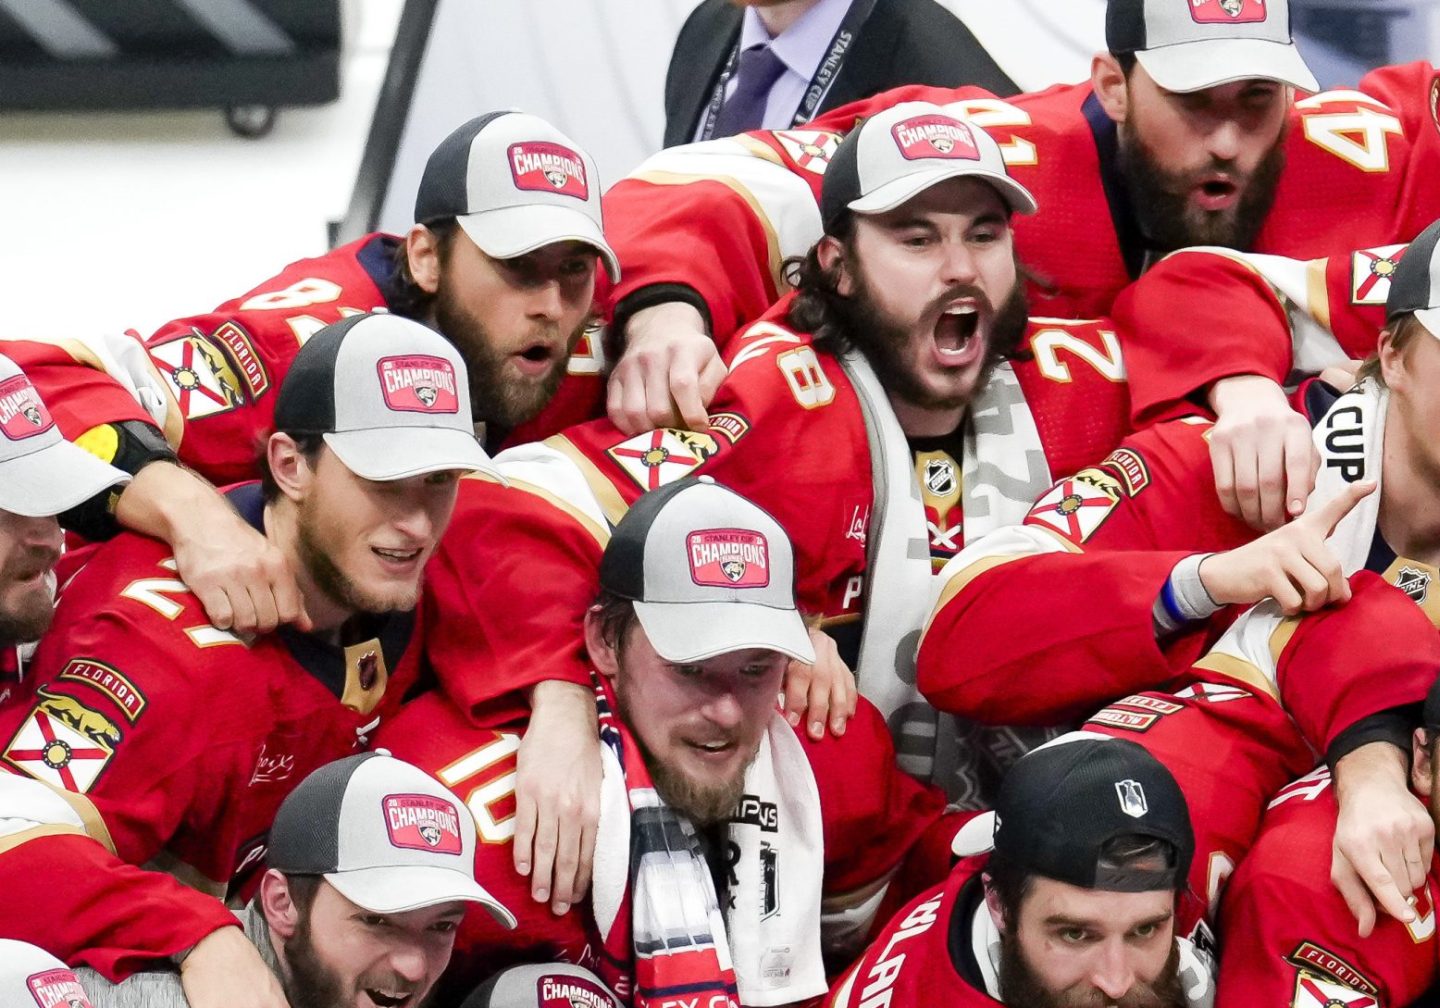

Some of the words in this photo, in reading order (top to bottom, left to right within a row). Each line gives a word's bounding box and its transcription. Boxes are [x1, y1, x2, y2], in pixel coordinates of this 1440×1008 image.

[899, 125, 974, 148] CHAMPIONS
[514, 153, 585, 186] CHAMPIONS
[223, 330, 261, 386] FLORIDA
[384, 369, 455, 396] CHAMPIONS
[1326, 406, 1365, 483] CUP
[692, 543, 765, 569] CHAMPIONS
[73, 663, 135, 708] FLORIDA
[389, 807, 460, 838] CHAMPIONS
[1306, 949, 1368, 991] FLORIDA
